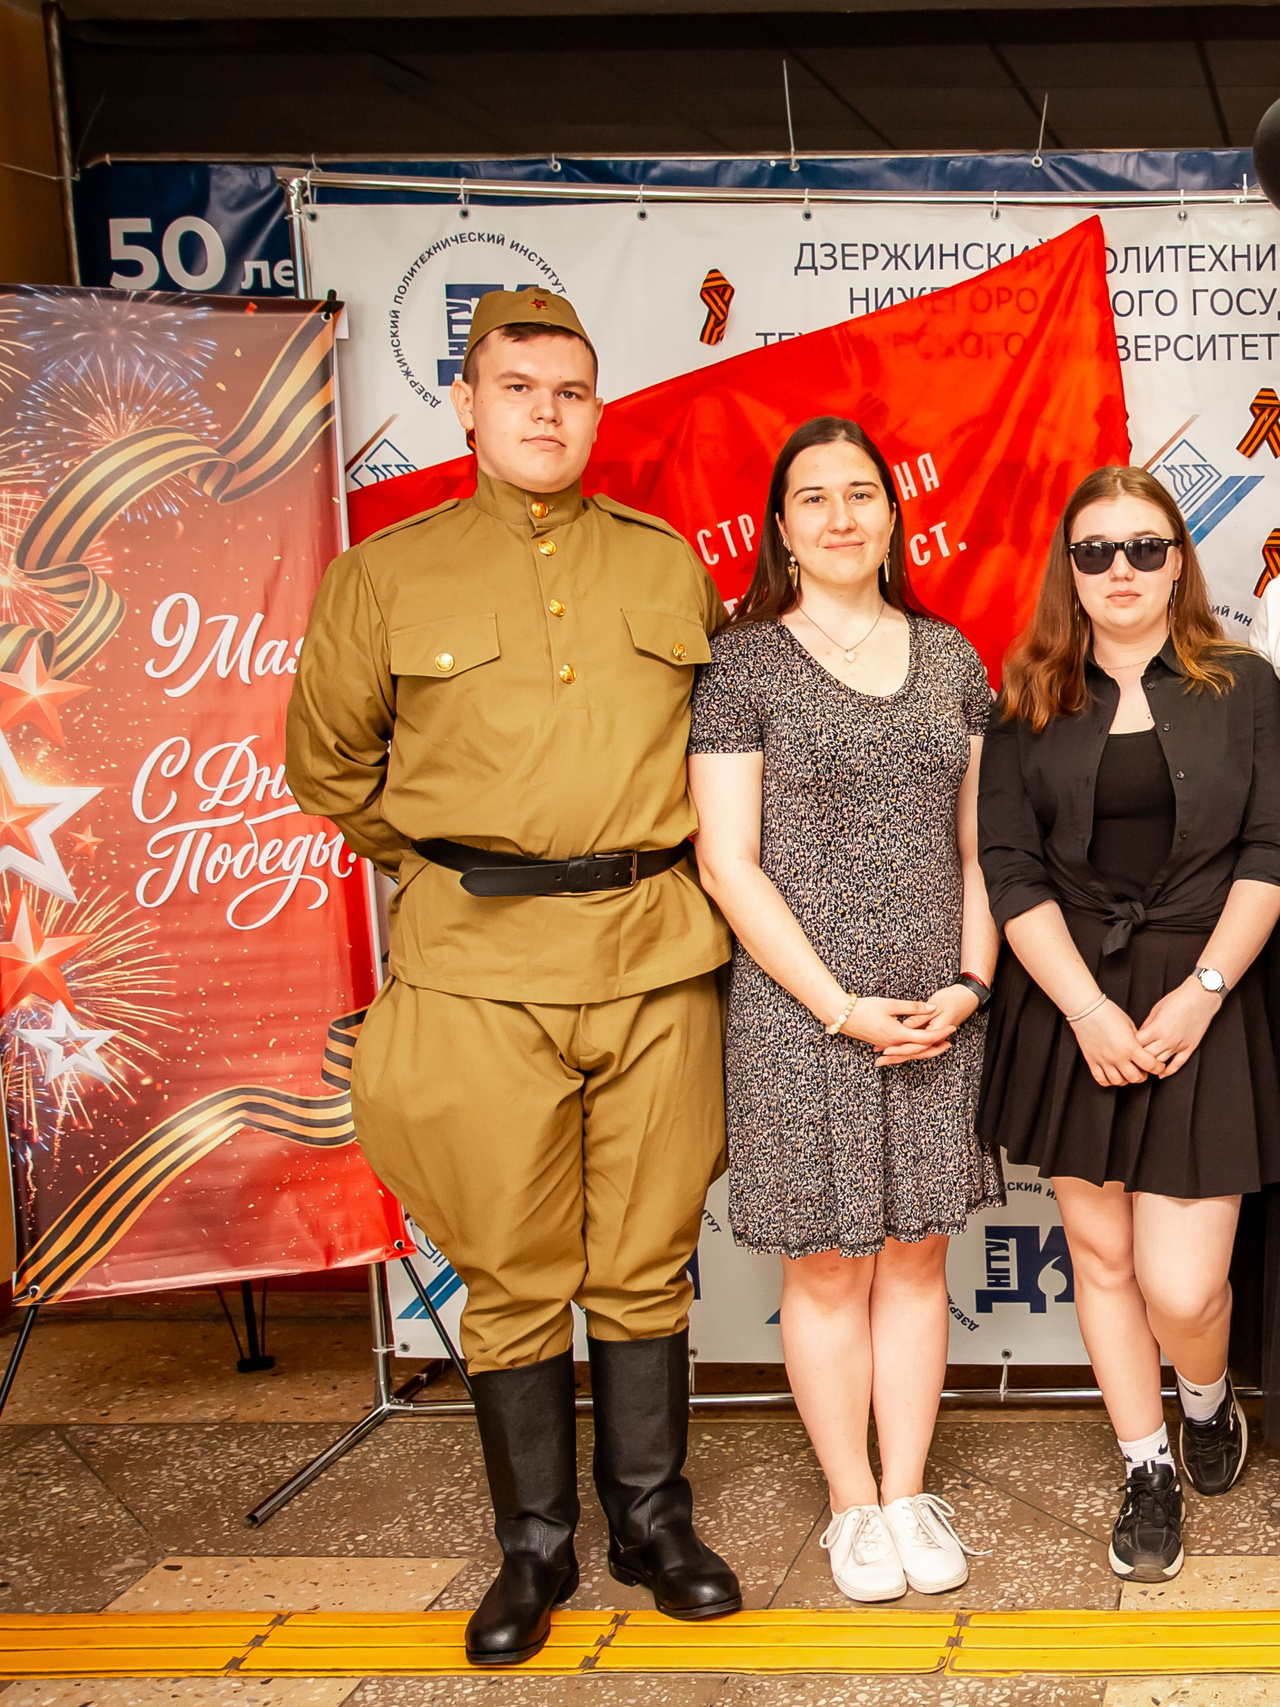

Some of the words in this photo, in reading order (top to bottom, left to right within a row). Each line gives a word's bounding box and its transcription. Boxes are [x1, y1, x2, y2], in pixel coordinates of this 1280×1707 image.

[109, 216, 226, 291] 50
[241, 259, 295, 290] ле
[393, 231, 506, 305] ПОЛИТЕХНИЧЕСКИЙ
[509, 239, 567, 295] ИНСТИТУТ
[389, 309, 442, 409] ДЗЕРЖИНСКИЙ
[144, 592, 201, 679] 9
[131, 736, 191, 824] С
[193, 734, 295, 812] Дн
